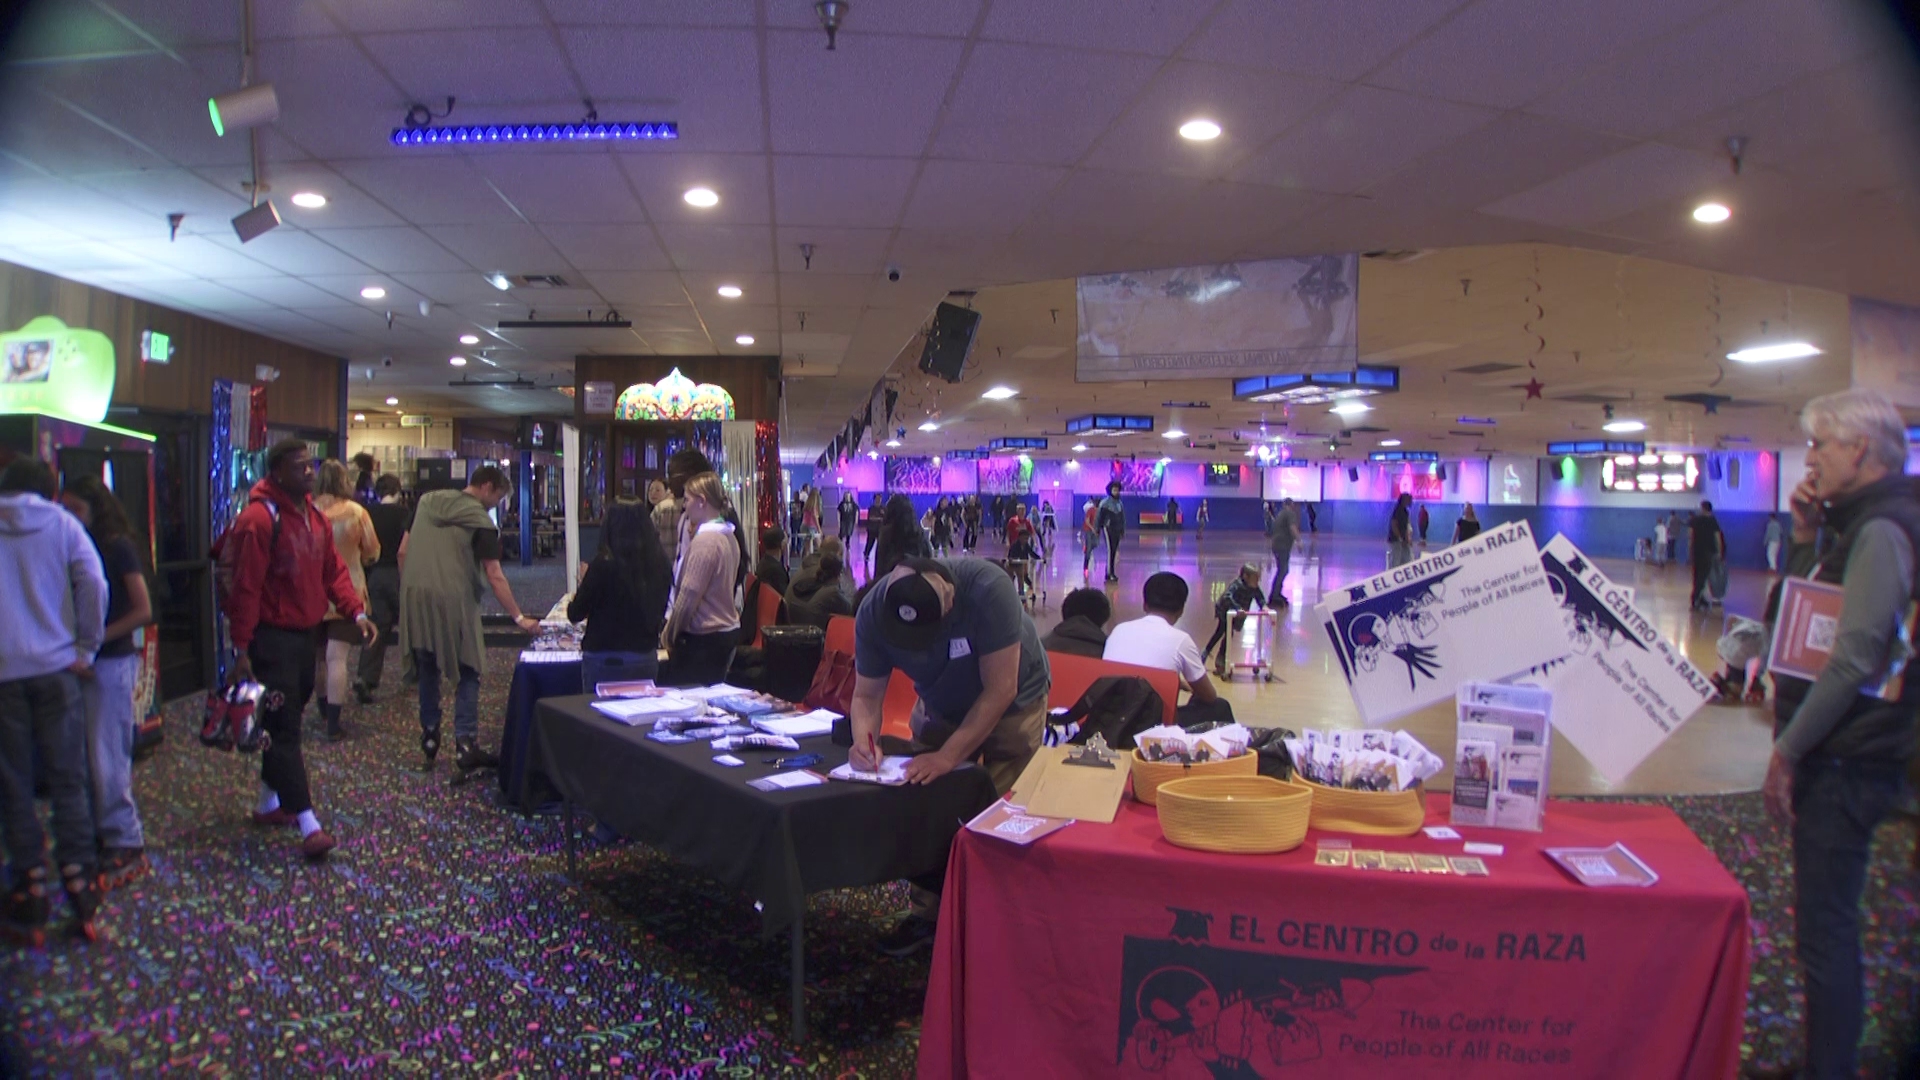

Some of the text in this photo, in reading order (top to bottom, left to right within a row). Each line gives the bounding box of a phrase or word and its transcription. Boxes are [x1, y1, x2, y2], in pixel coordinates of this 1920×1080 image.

[1372, 524, 1528, 593] EL CENTRO de la RAZA
[1460, 562, 1539, 599] The Center for
[1440, 576, 1546, 621] People of All Races
[1587, 573, 1605, 593] EL
[1605, 590, 1658, 642] CENTRO
[1656, 641, 1669, 655] de
[1675, 660, 1711, 698] RAZA
[1592, 650, 1671, 733] People of All Races
[1620, 658, 1681, 723] The Center for
[1230, 913, 1587, 962] EL CENTRO de la RAZA
[1398, 1007, 1577, 1036] The Center for
[1339, 1032, 1574, 1065] People of All Races
